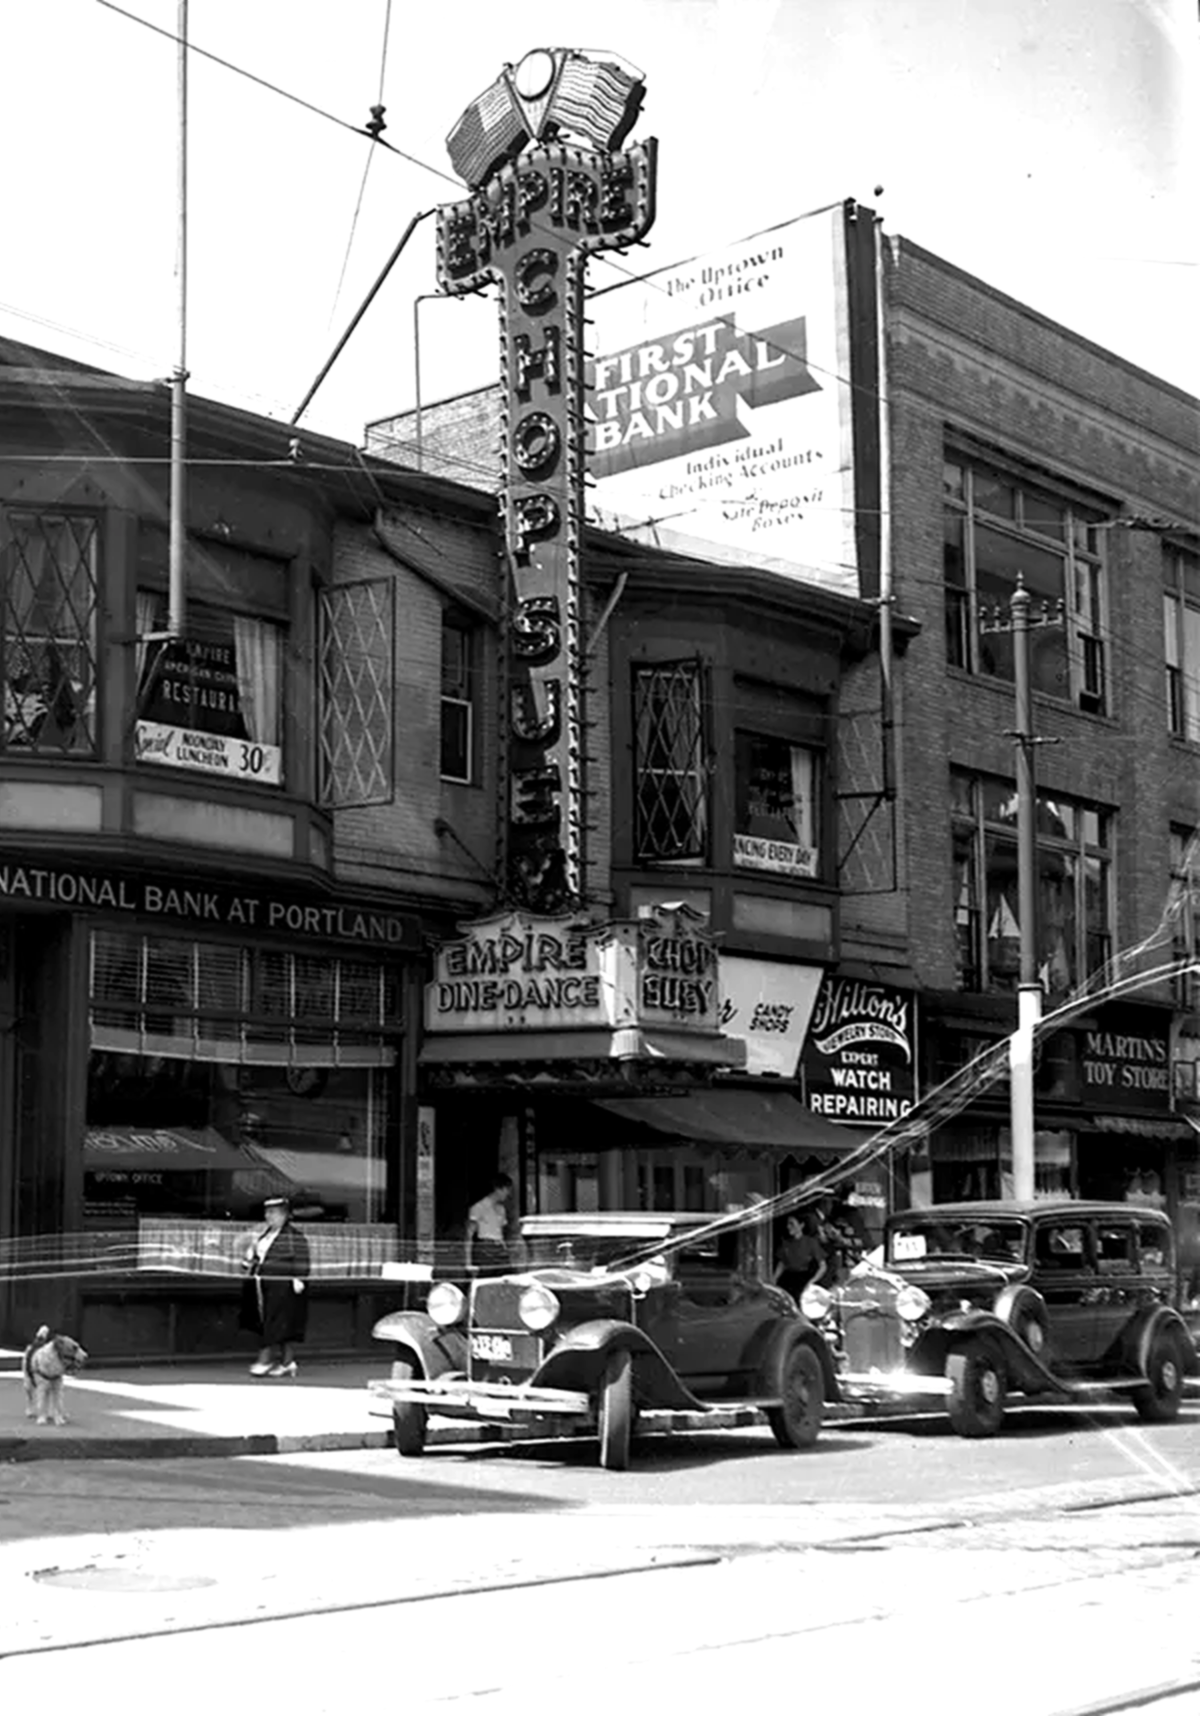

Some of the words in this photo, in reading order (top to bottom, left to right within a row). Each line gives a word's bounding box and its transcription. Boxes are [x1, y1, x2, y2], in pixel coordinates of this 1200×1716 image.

[449, 167, 636, 279] EMPIRE
[667, 277, 696, 297] The
[701, 246, 784, 286] Uptown
[594, 321, 727, 391] FIRST
[584, 341, 787, 421] TIONAL
[513, 247, 563, 568] CHOP
[594, 391, 720, 451] BANK
[687, 438, 783, 476] Individual
[740, 449, 824, 478] Accounts
[162, 679, 236, 712] RESTAURA
[144, 885, 221, 920] BANK
[226, 897, 260, 925] AT
[268, 901, 404, 943] PORTLAND
[445, 932, 588, 976] EMPIRE
[648, 938, 718, 975] CHOP
[643, 973, 713, 1015] SUEY
[755, 1002, 795, 1018] CANDY
[811, 979, 908, 1034] Hilton's
[749, 1017, 789, 1034] SHOPS
[840, 1050, 879, 1066] EXPERT
[1086, 1032, 1166, 1063] MARTIN'S
[830, 1067, 892, 1091] WATCH
[1083, 1060, 1117, 1086] TOY
[1121, 1065, 1170, 1091] STORE
[810, 1092, 913, 1118] REPAIRING
[131, 1172, 164, 1185] OFFICE
